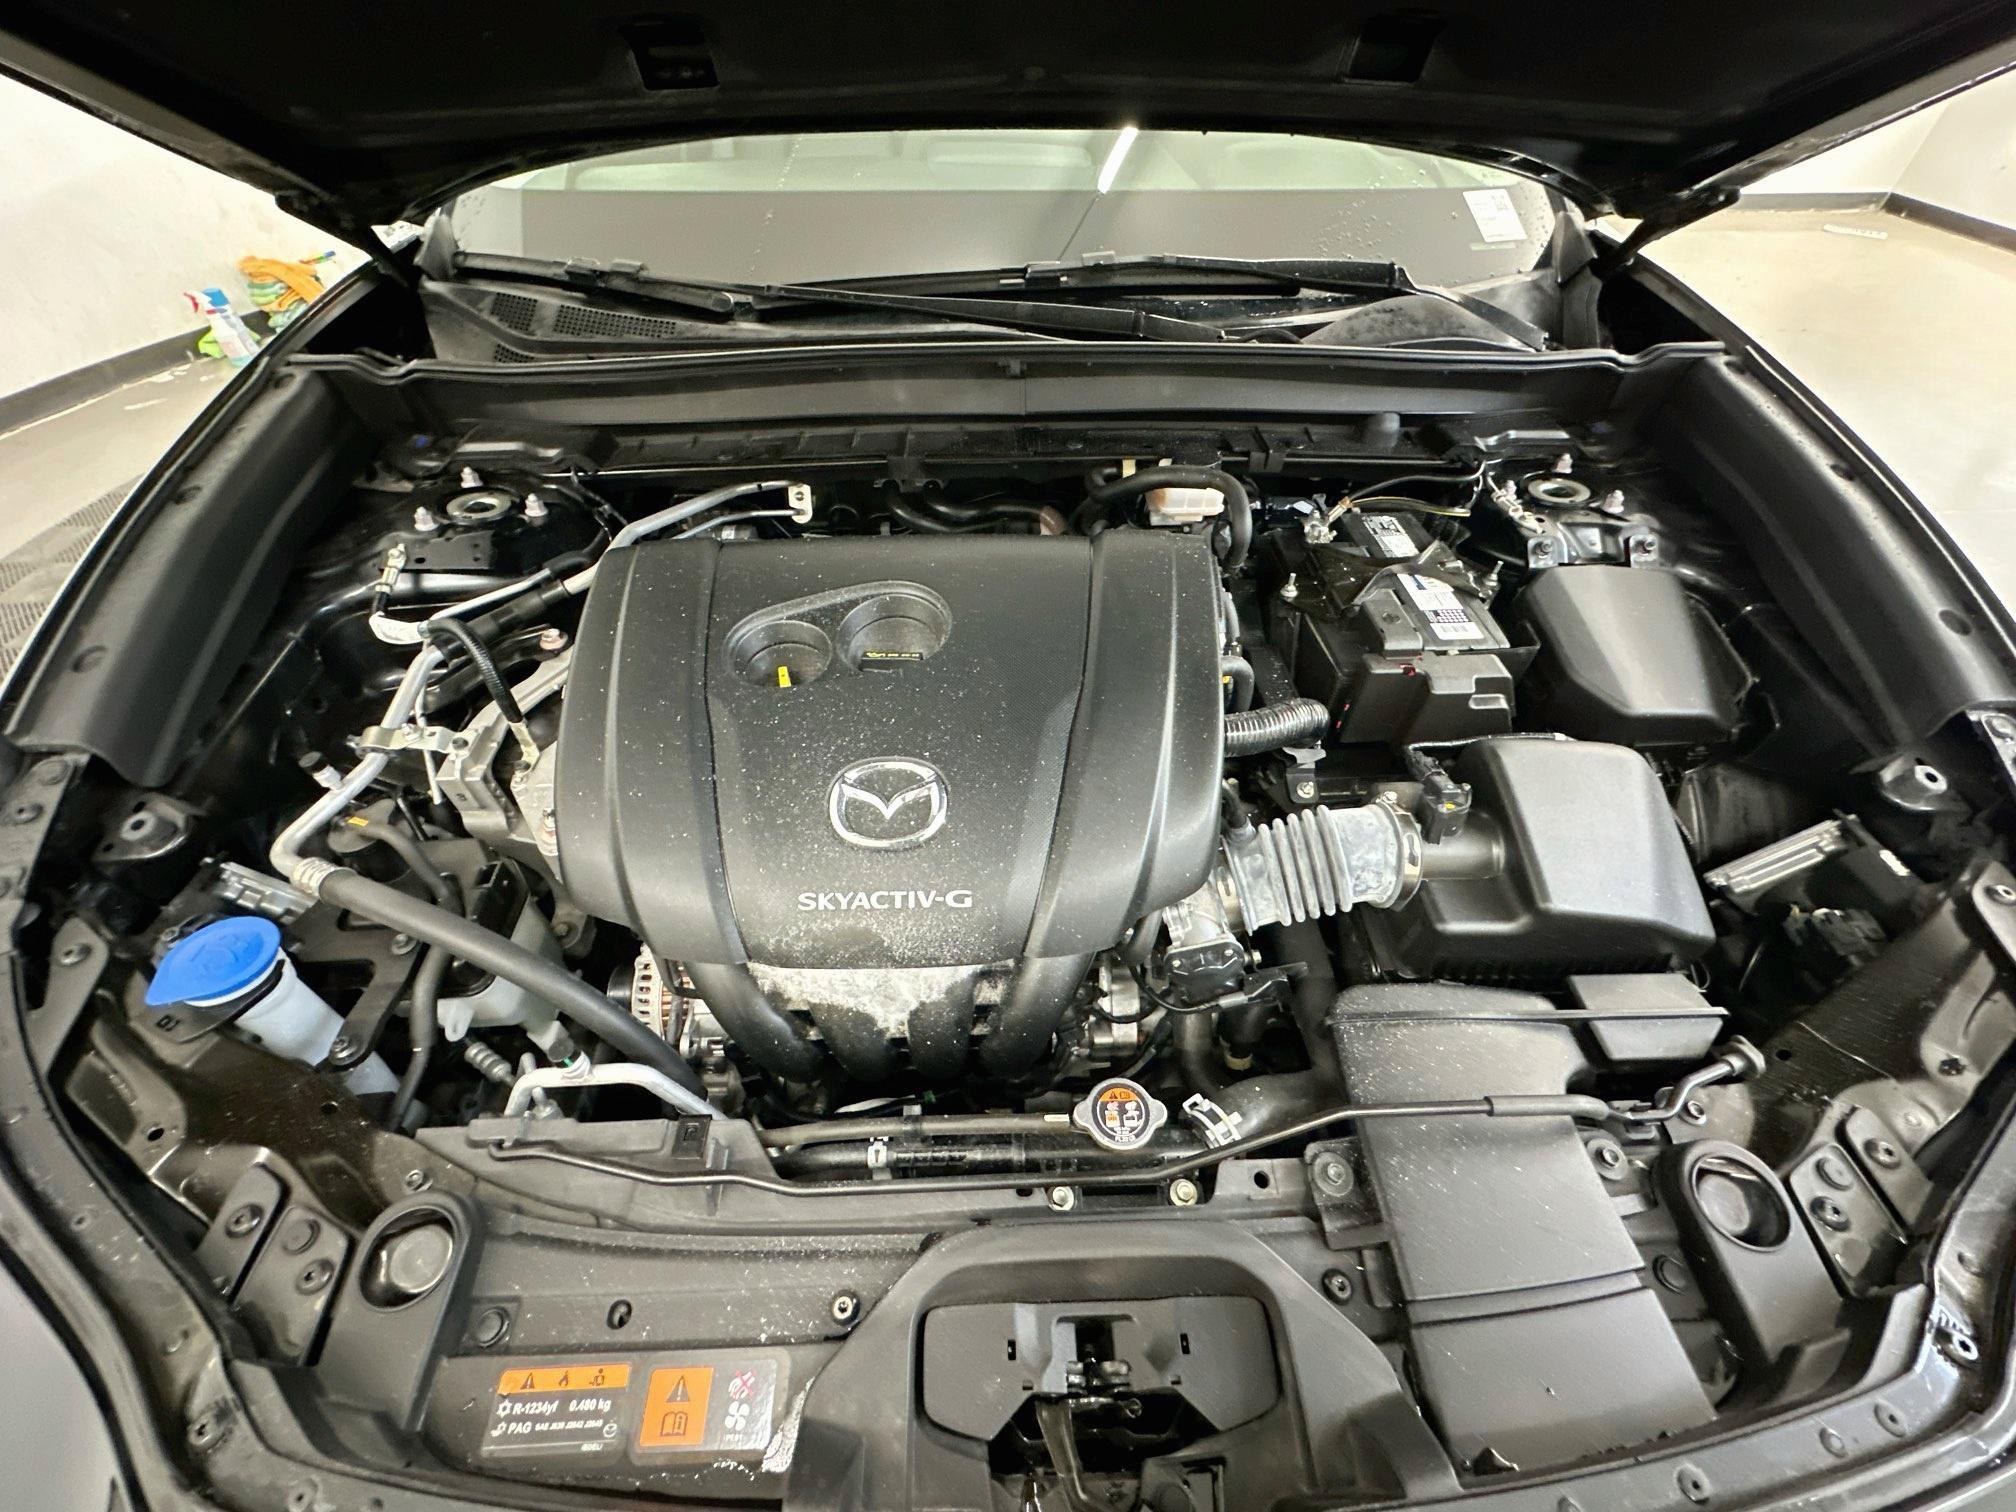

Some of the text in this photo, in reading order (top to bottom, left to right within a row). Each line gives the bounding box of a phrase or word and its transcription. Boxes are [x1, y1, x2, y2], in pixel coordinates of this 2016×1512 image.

[797, 889, 973, 911] SKYACTIV-G
[512, 1400, 560, 1416] R-1234yf
[597, 1398, 612, 1412] kg
[507, 1421, 532, 1435] PAG
